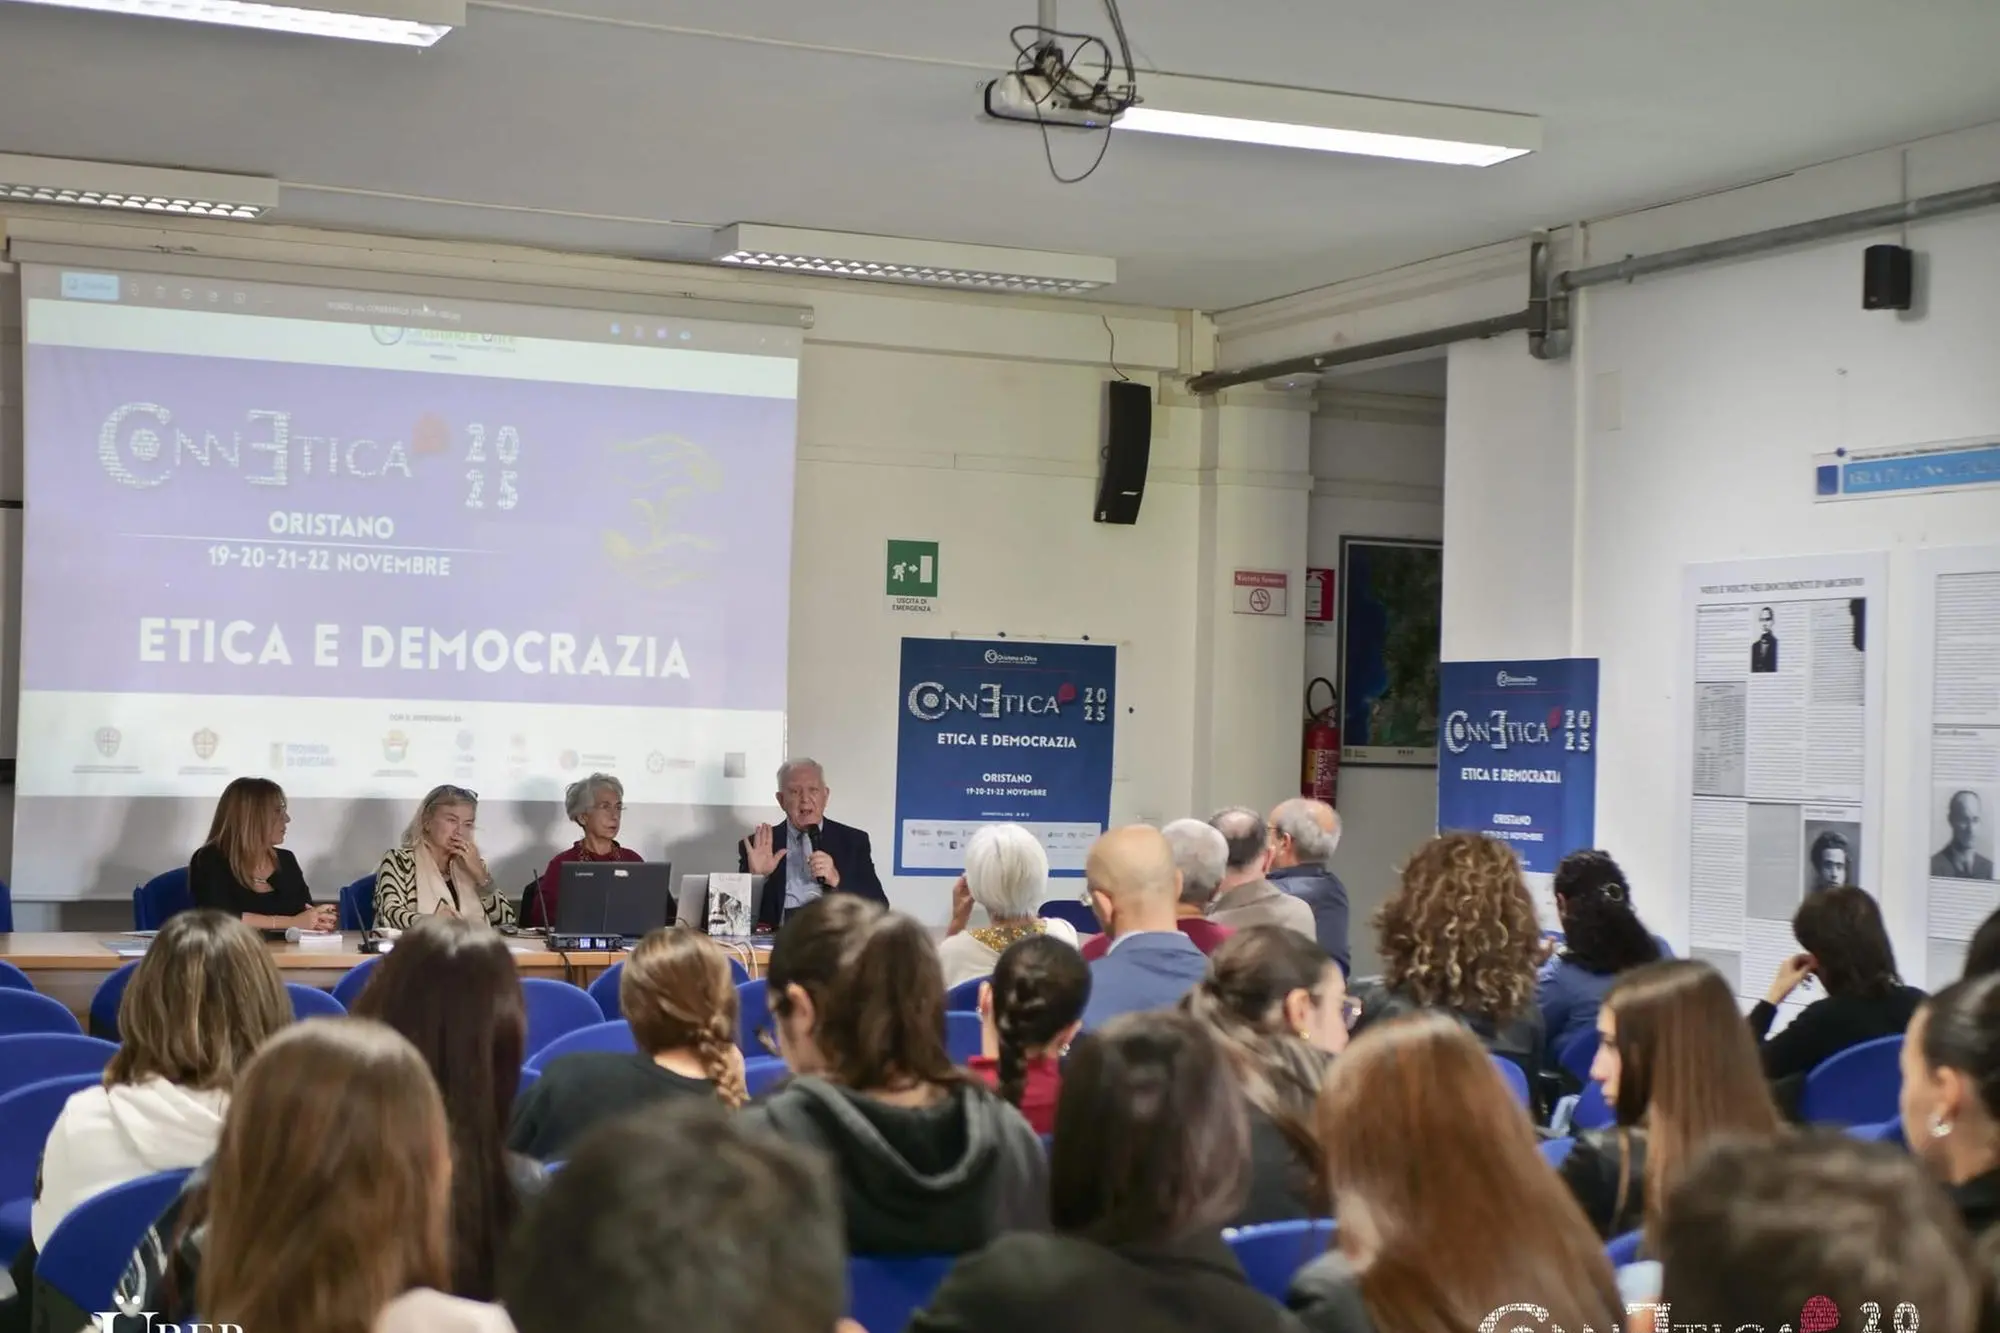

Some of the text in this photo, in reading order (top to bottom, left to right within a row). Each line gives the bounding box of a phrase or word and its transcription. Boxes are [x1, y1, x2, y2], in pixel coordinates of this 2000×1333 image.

[465, 423, 520, 463] 20
[464, 468, 519, 509] 25
[268, 510, 395, 540] ORISTANO
[208, 545, 451, 576] 19-20-21-22 NOVEMBRE
[892, 604, 931, 612] EMERGENZA
[138, 617, 692, 679] ETICA E DEMOCRAZIA
[1084, 687, 1107, 703] 20
[1084, 705, 1106, 722] 25
[1564, 709, 1592, 728] 20
[937, 733, 1077, 749] ETICA E DEMOCRAZIA
[1564, 732, 1591, 751] 25
[982, 773, 1033, 784] ORISTANO
[1461, 767, 1490, 780] ETICA
[1492, 768, 1500, 781] E
[966, 787, 1048, 797] 19-20-21-22 NOVEMBRE
